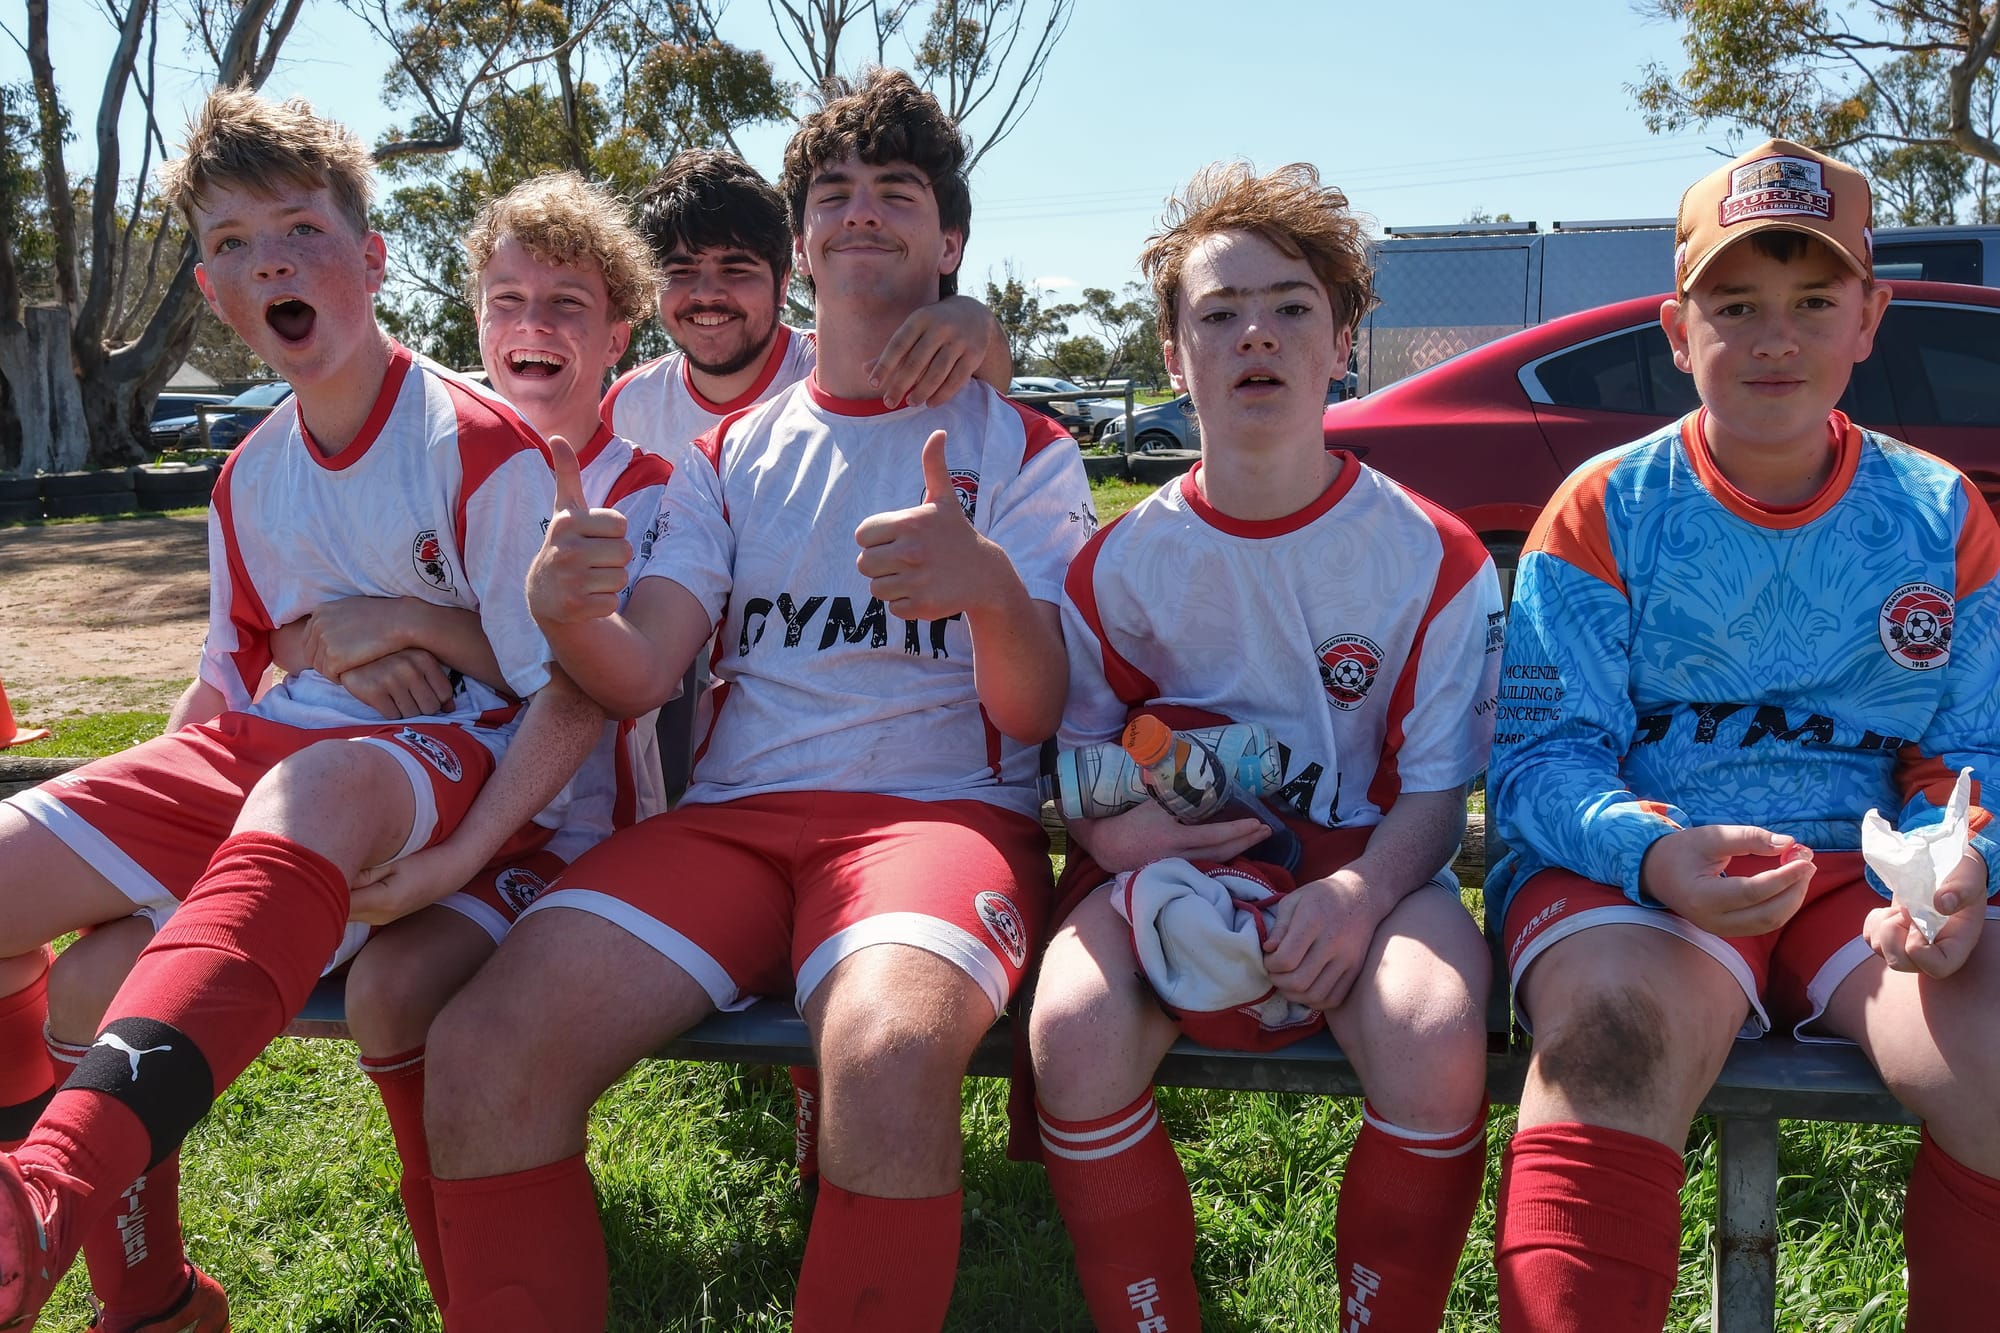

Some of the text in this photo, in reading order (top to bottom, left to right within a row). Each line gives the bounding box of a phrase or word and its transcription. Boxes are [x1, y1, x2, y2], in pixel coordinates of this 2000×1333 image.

[1726, 188, 1829, 215] BURKE
[1770, 203, 1813, 211] TRANSPORT
[1499, 685, 1553, 701] UILDING
